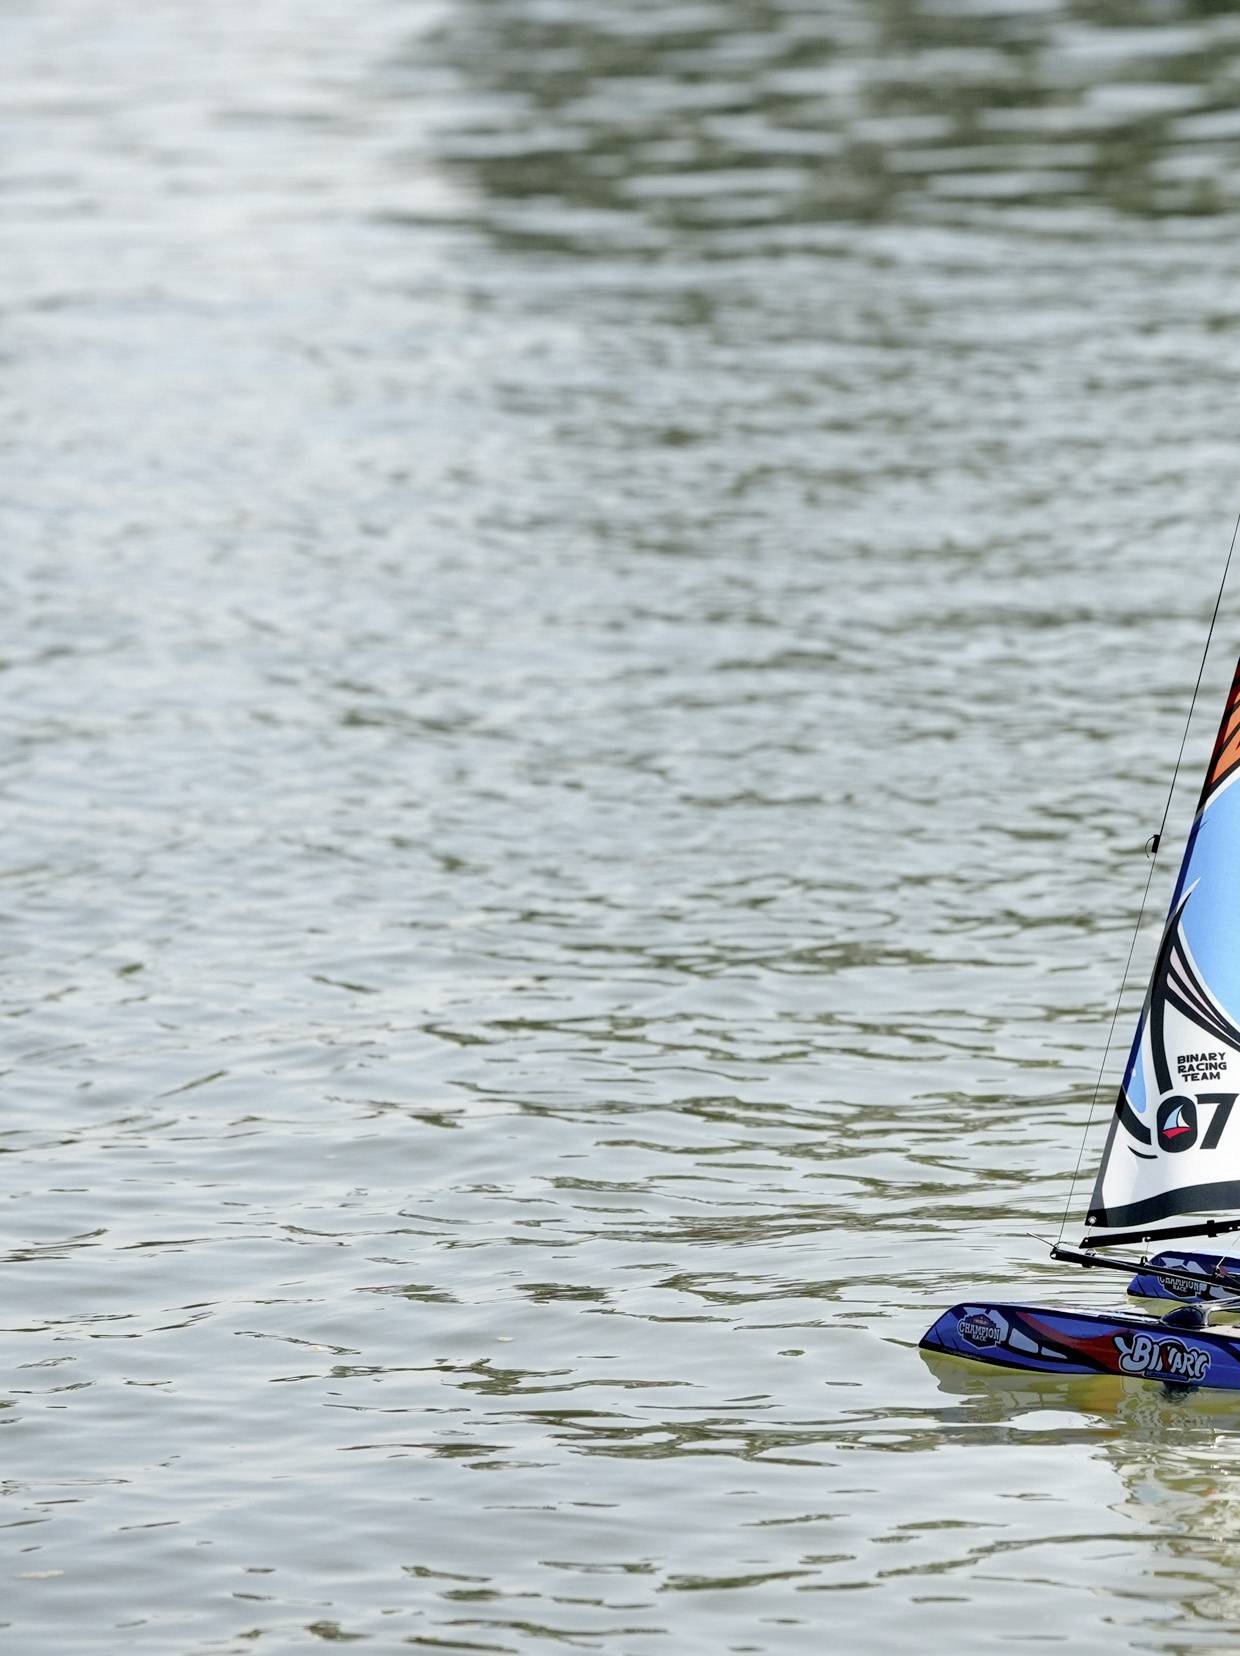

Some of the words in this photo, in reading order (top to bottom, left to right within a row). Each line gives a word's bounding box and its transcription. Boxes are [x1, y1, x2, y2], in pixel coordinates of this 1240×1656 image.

[1177, 1052, 1226, 1064] BINARY
[1177, 1062, 1227, 1074] RACING
[1182, 1071, 1221, 1082] TEAM
[1157, 1093, 1240, 1153] 07
[959, 1321, 1000, 1341] CHAMPION
